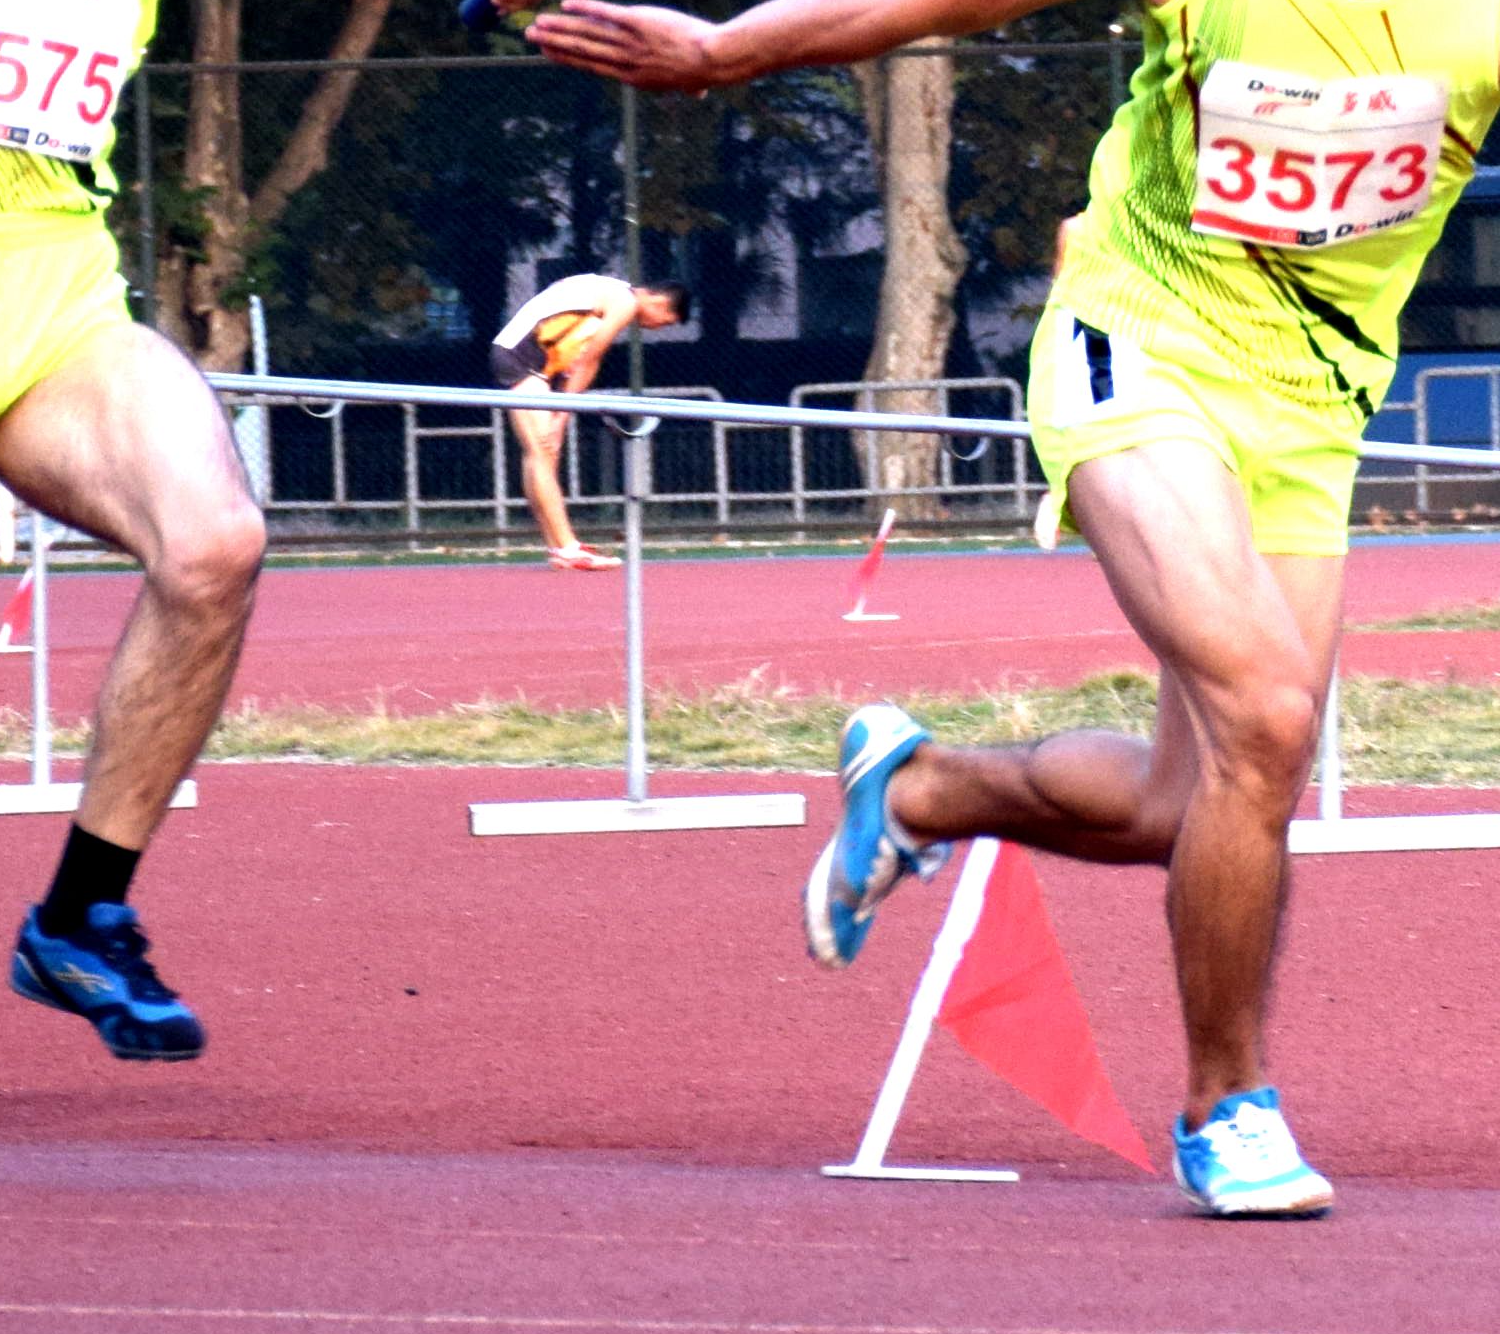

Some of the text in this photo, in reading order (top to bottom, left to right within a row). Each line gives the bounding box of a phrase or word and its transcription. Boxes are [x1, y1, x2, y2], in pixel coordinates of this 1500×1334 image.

[1247, 79, 1322, 101] Do-win
[35, 131, 92, 156] Do-win
[1206, 137, 1428, 213] 3573
[1334, 209, 1414, 238] Do-win
